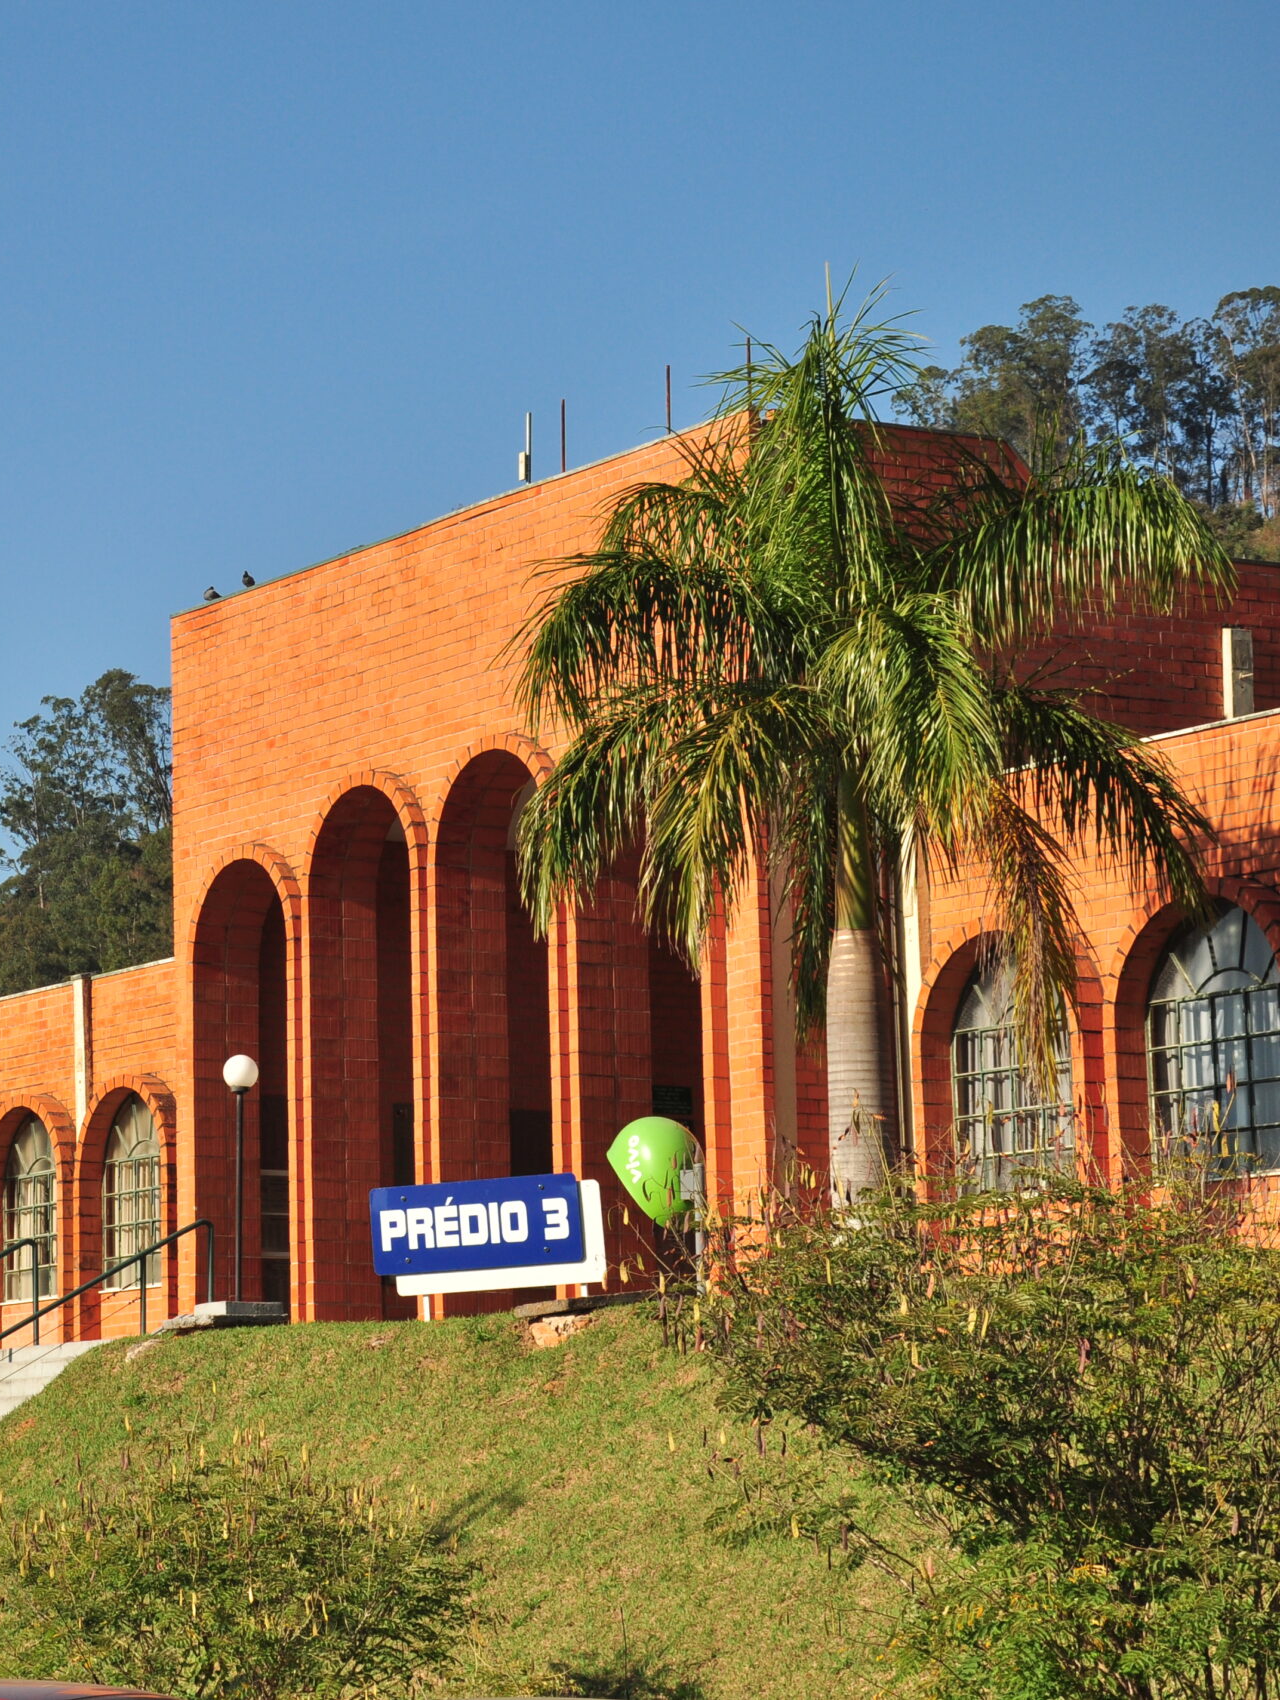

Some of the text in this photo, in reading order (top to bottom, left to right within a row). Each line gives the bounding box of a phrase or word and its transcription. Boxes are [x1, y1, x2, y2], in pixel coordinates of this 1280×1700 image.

[626, 1135, 642, 1184] vivo
[380, 1197, 569, 1252] PRÉDIO 3
